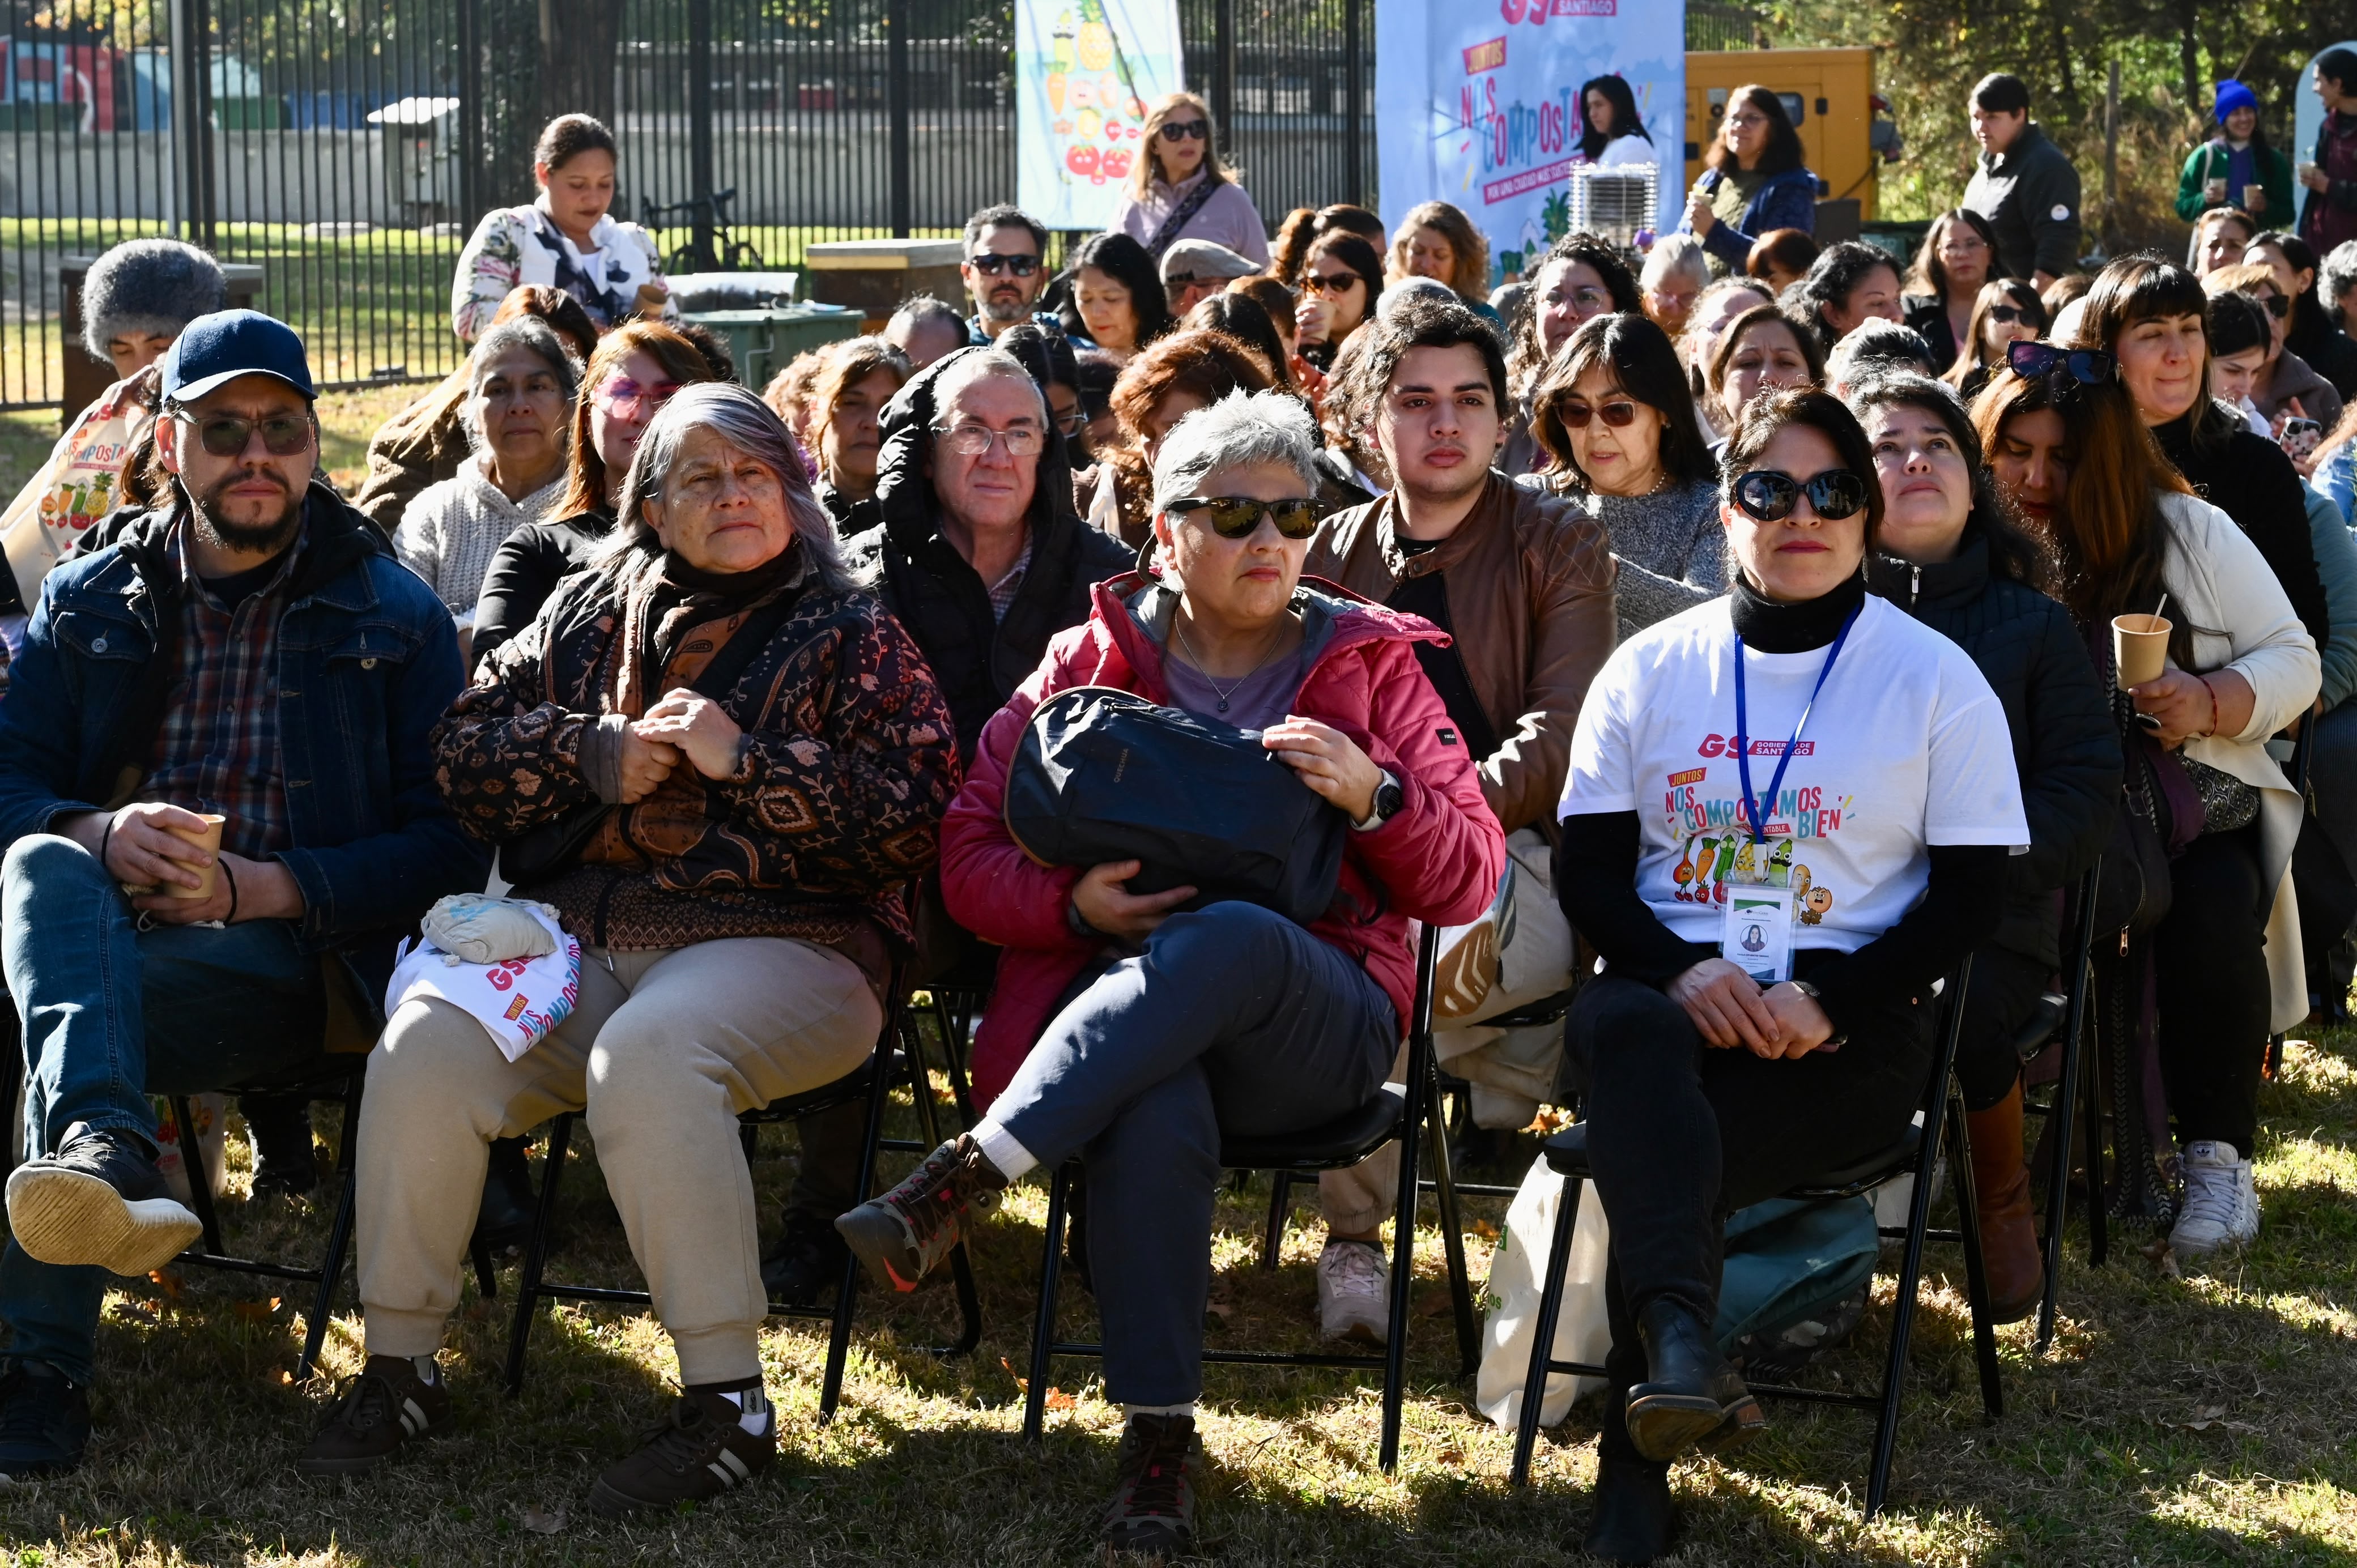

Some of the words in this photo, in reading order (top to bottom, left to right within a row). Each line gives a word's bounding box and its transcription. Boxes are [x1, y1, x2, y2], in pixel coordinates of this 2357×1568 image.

[1468, 40, 1504, 73] JUNTOS
[1461, 76, 1496, 129] NOS
[1483, 87, 1582, 173] COMPOSTA
[1114, 748, 1129, 783] QUECHUA
[1672, 770, 1702, 786] JUNTOS
[1666, 786, 1694, 813] NOS
[1797, 809, 1841, 839] BIEN
[486, 960, 526, 991] GS
[508, 996, 526, 1020] JUNTOS
[517, 1010, 543, 1040] NOS
